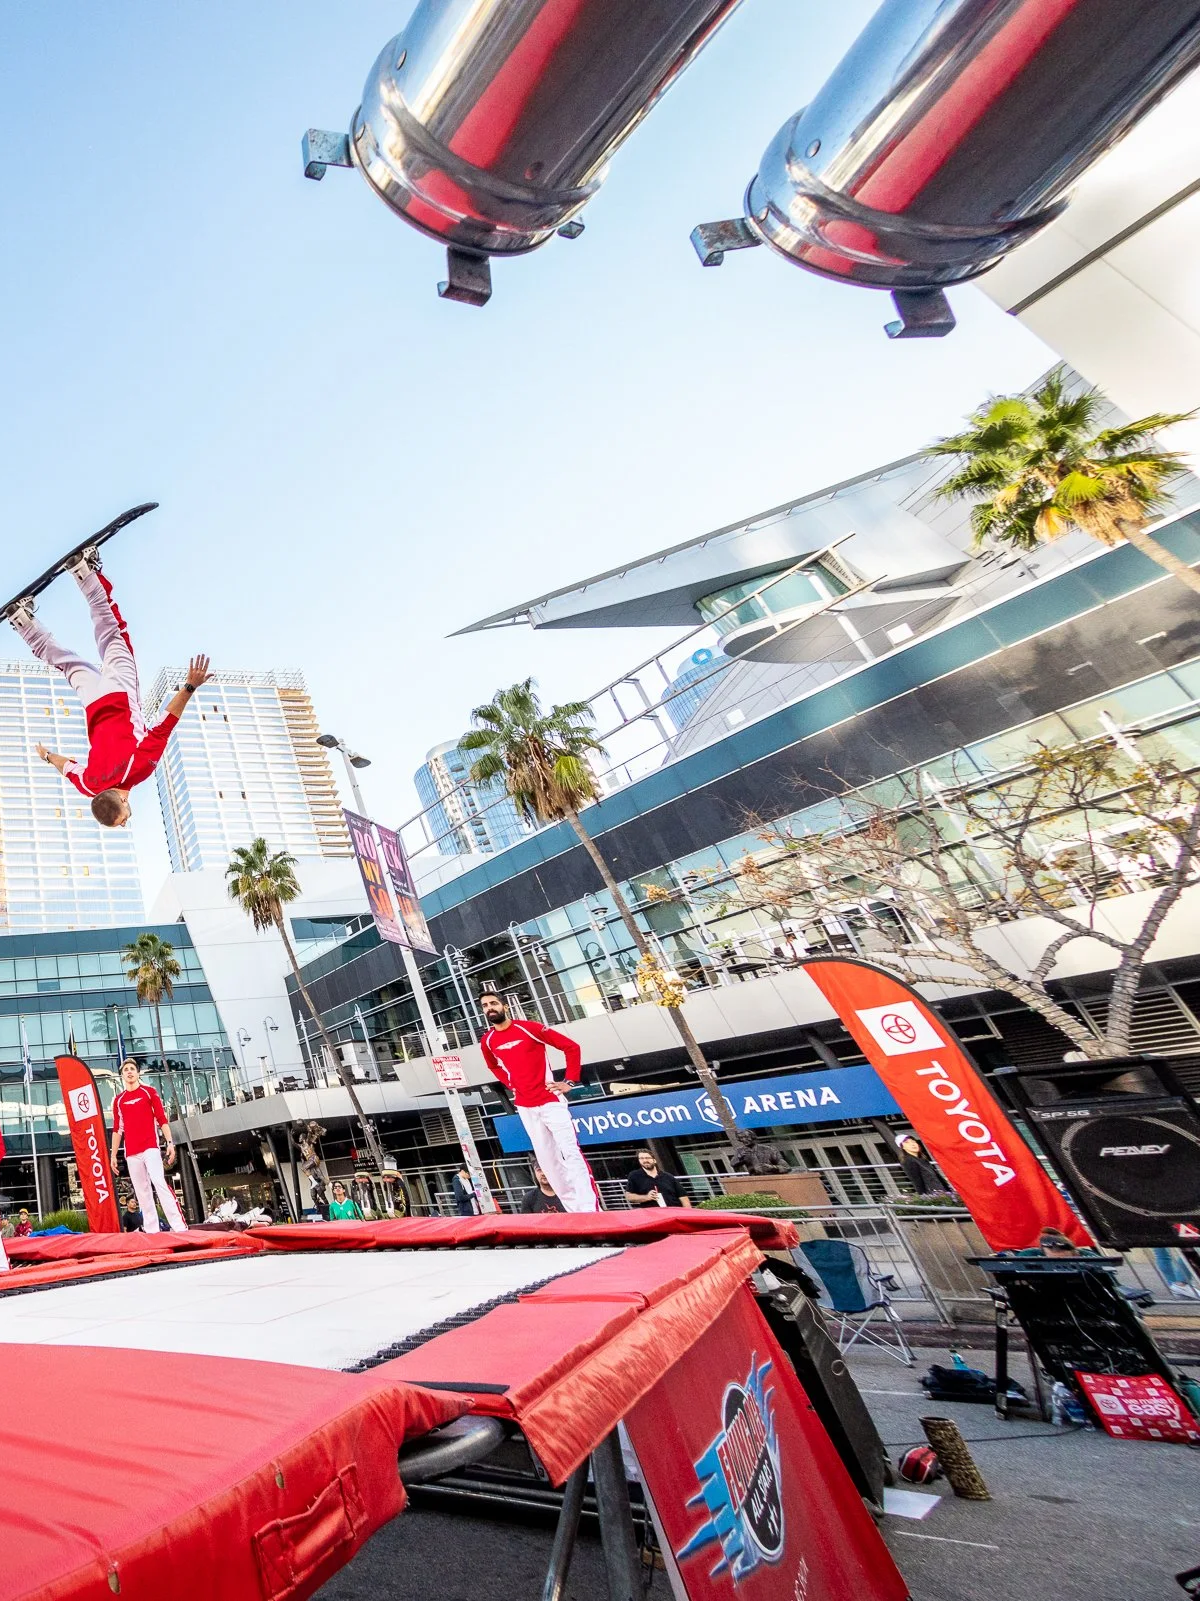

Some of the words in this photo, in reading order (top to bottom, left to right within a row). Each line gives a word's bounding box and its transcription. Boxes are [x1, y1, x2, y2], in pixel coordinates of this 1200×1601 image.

[572, 1103, 692, 1135] rypto.com
[743, 1086, 841, 1115] ARENA
[915, 1060, 1017, 1187] TOYOTA
[85, 1124, 110, 1203] TOYOTA
[1099, 1144, 1171, 1157] PEAVEY
[1128, 1402, 1182, 1420] easy
[750, 1487, 765, 1525] ALL
